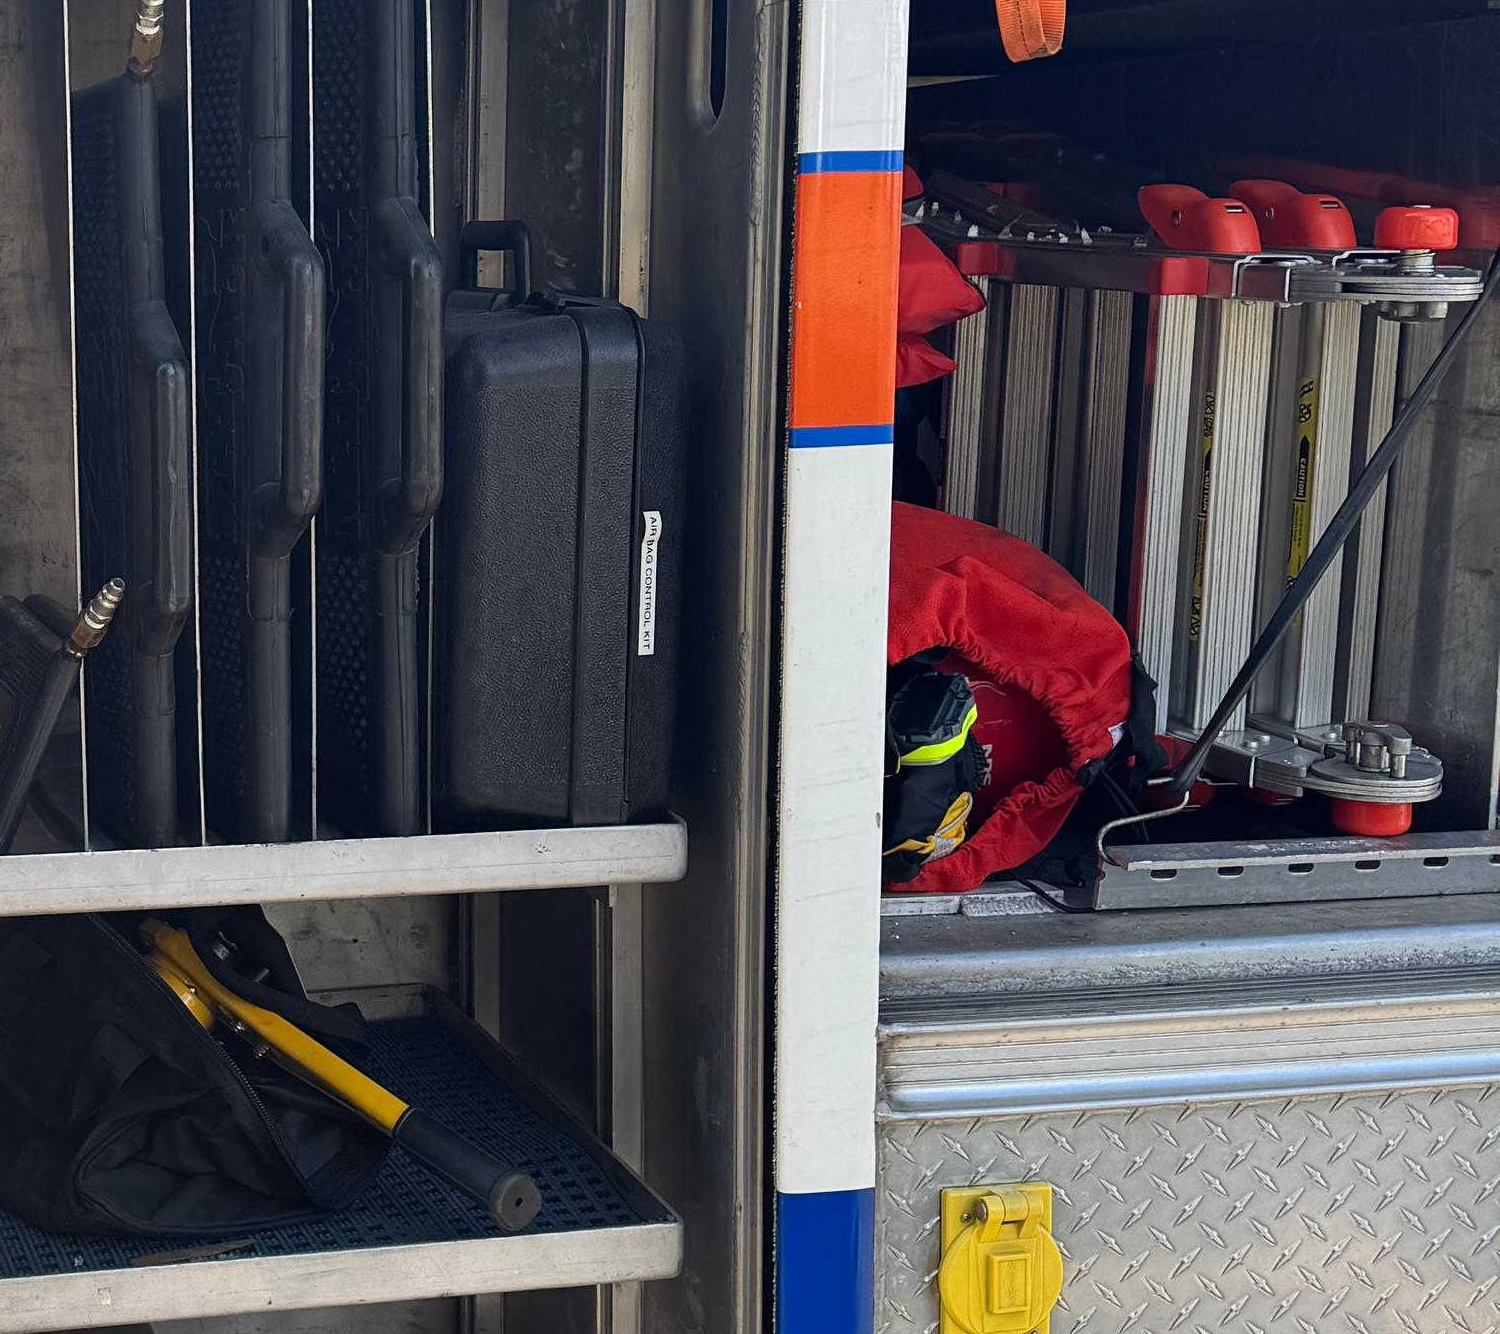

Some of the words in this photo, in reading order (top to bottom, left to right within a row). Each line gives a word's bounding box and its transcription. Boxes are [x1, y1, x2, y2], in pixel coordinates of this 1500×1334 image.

[1296, 457, 1308, 498] CAUTION
[650, 516, 658, 537] AIR
[643, 567, 653, 628] CONTROL
[643, 630, 651, 650] KIT
